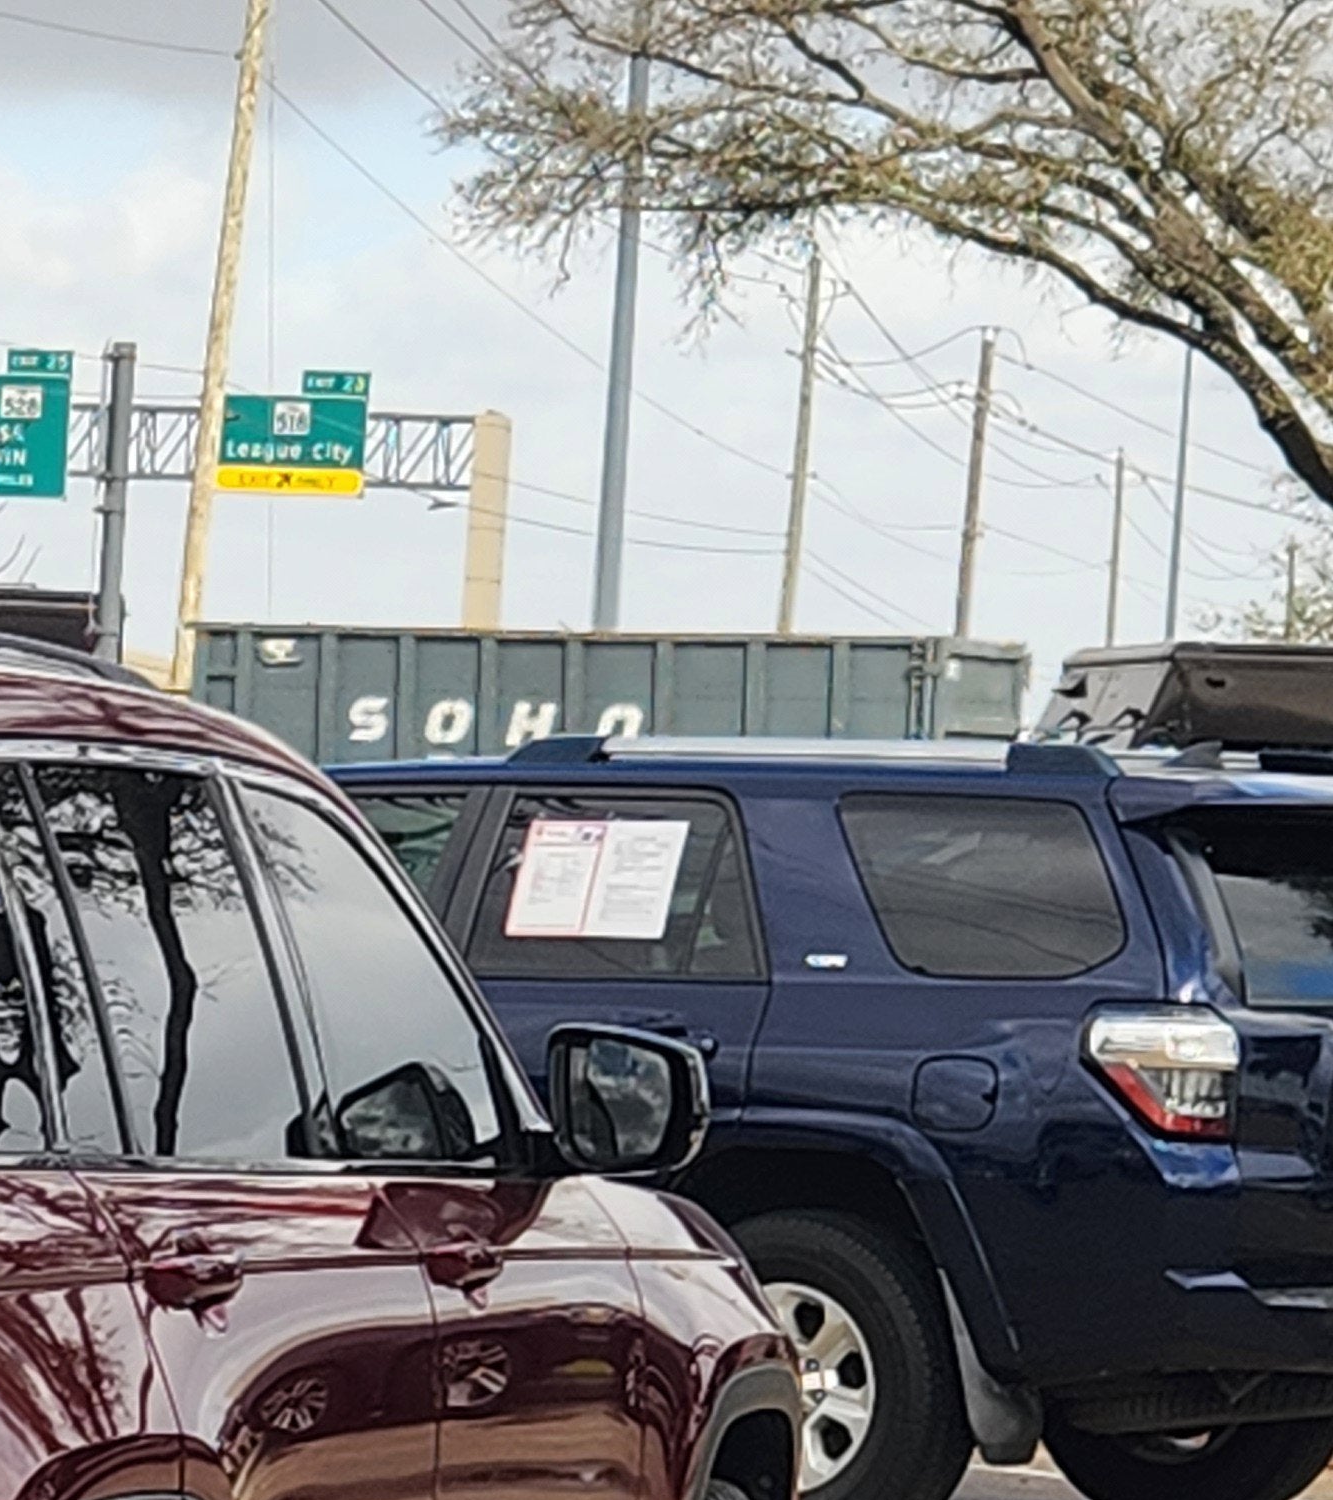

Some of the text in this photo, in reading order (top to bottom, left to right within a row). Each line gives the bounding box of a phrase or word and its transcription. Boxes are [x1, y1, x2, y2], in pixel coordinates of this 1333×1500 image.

[225, 439, 353, 466] League City
[348, 696, 644, 747] SOHO
